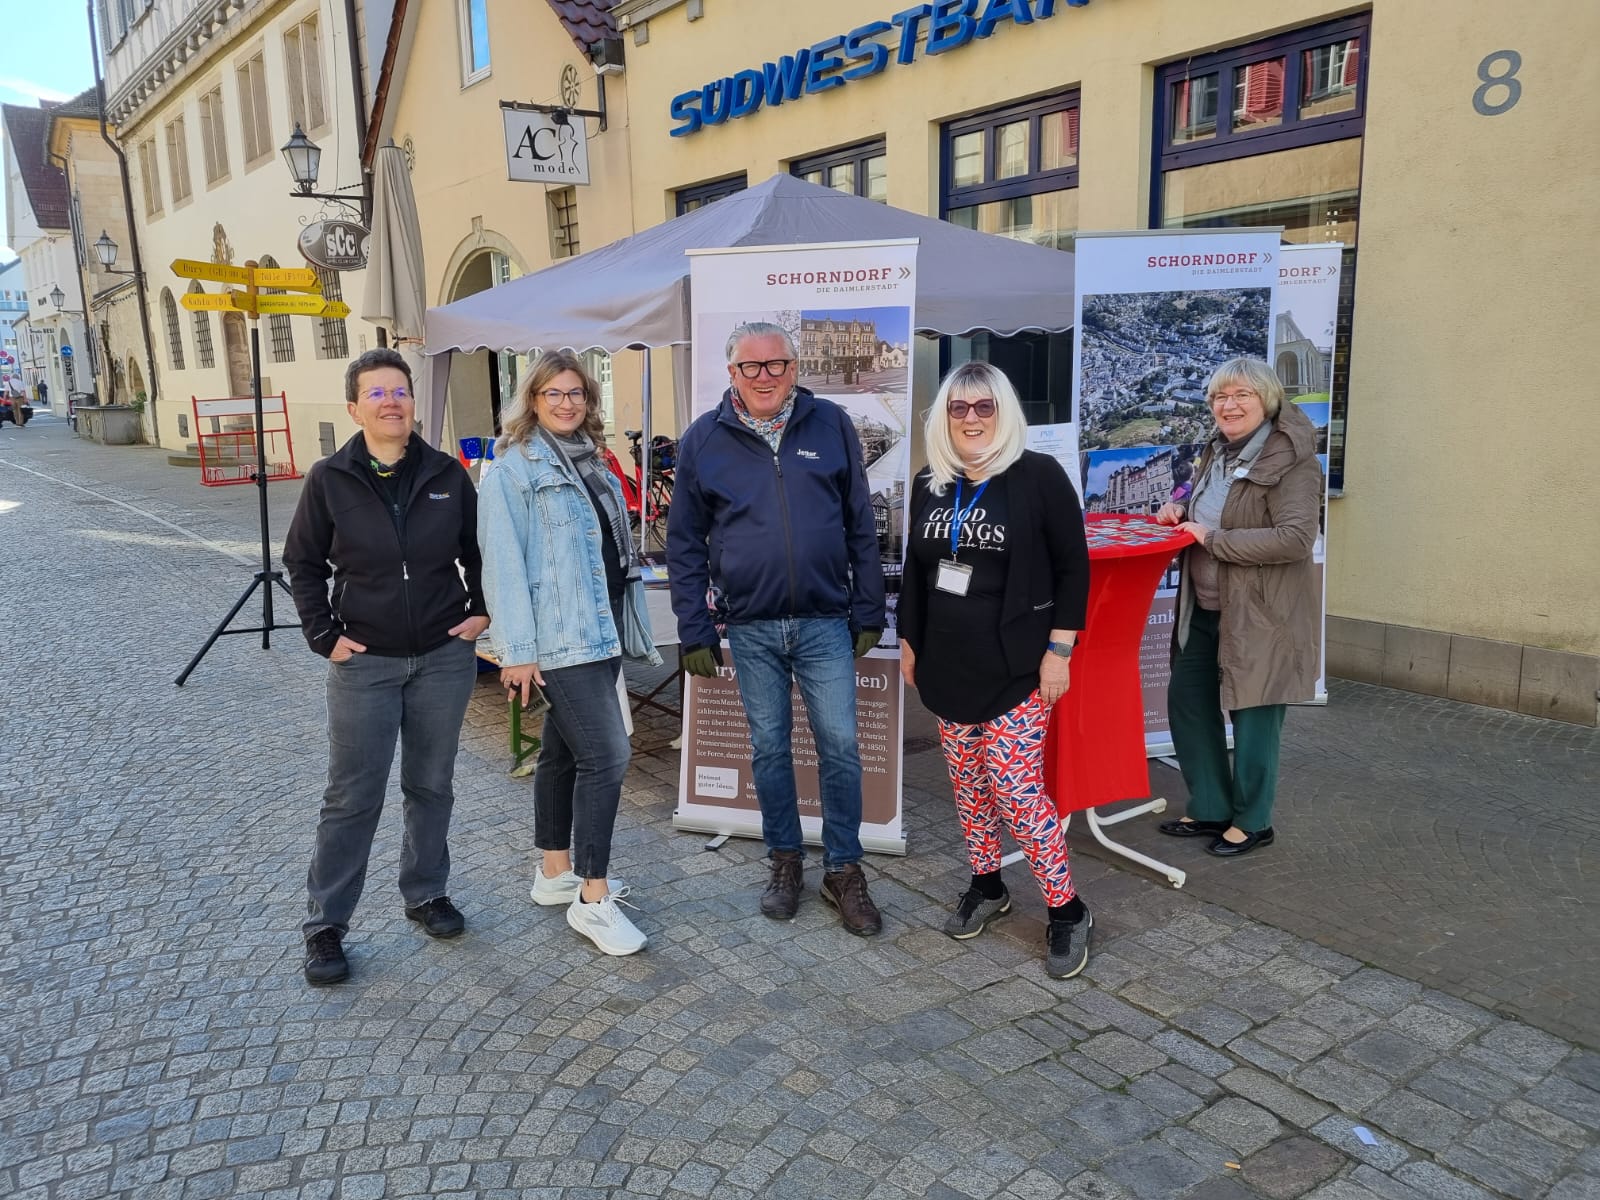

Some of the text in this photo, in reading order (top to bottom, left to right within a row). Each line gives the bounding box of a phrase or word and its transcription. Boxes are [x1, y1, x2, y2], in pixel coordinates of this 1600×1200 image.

[1472, 49, 1522, 116] 8
[512, 124, 556, 160] AC
[533, 161, 575, 175] mode
[1147, 252, 1258, 268] SCHORNDORF
[766, 267, 892, 285] SCHORNDORF
[833, 283, 898, 292] DAIMLERSTADT
[929, 507, 987, 522] GOOD
[923, 522, 1005, 543] THNGS
